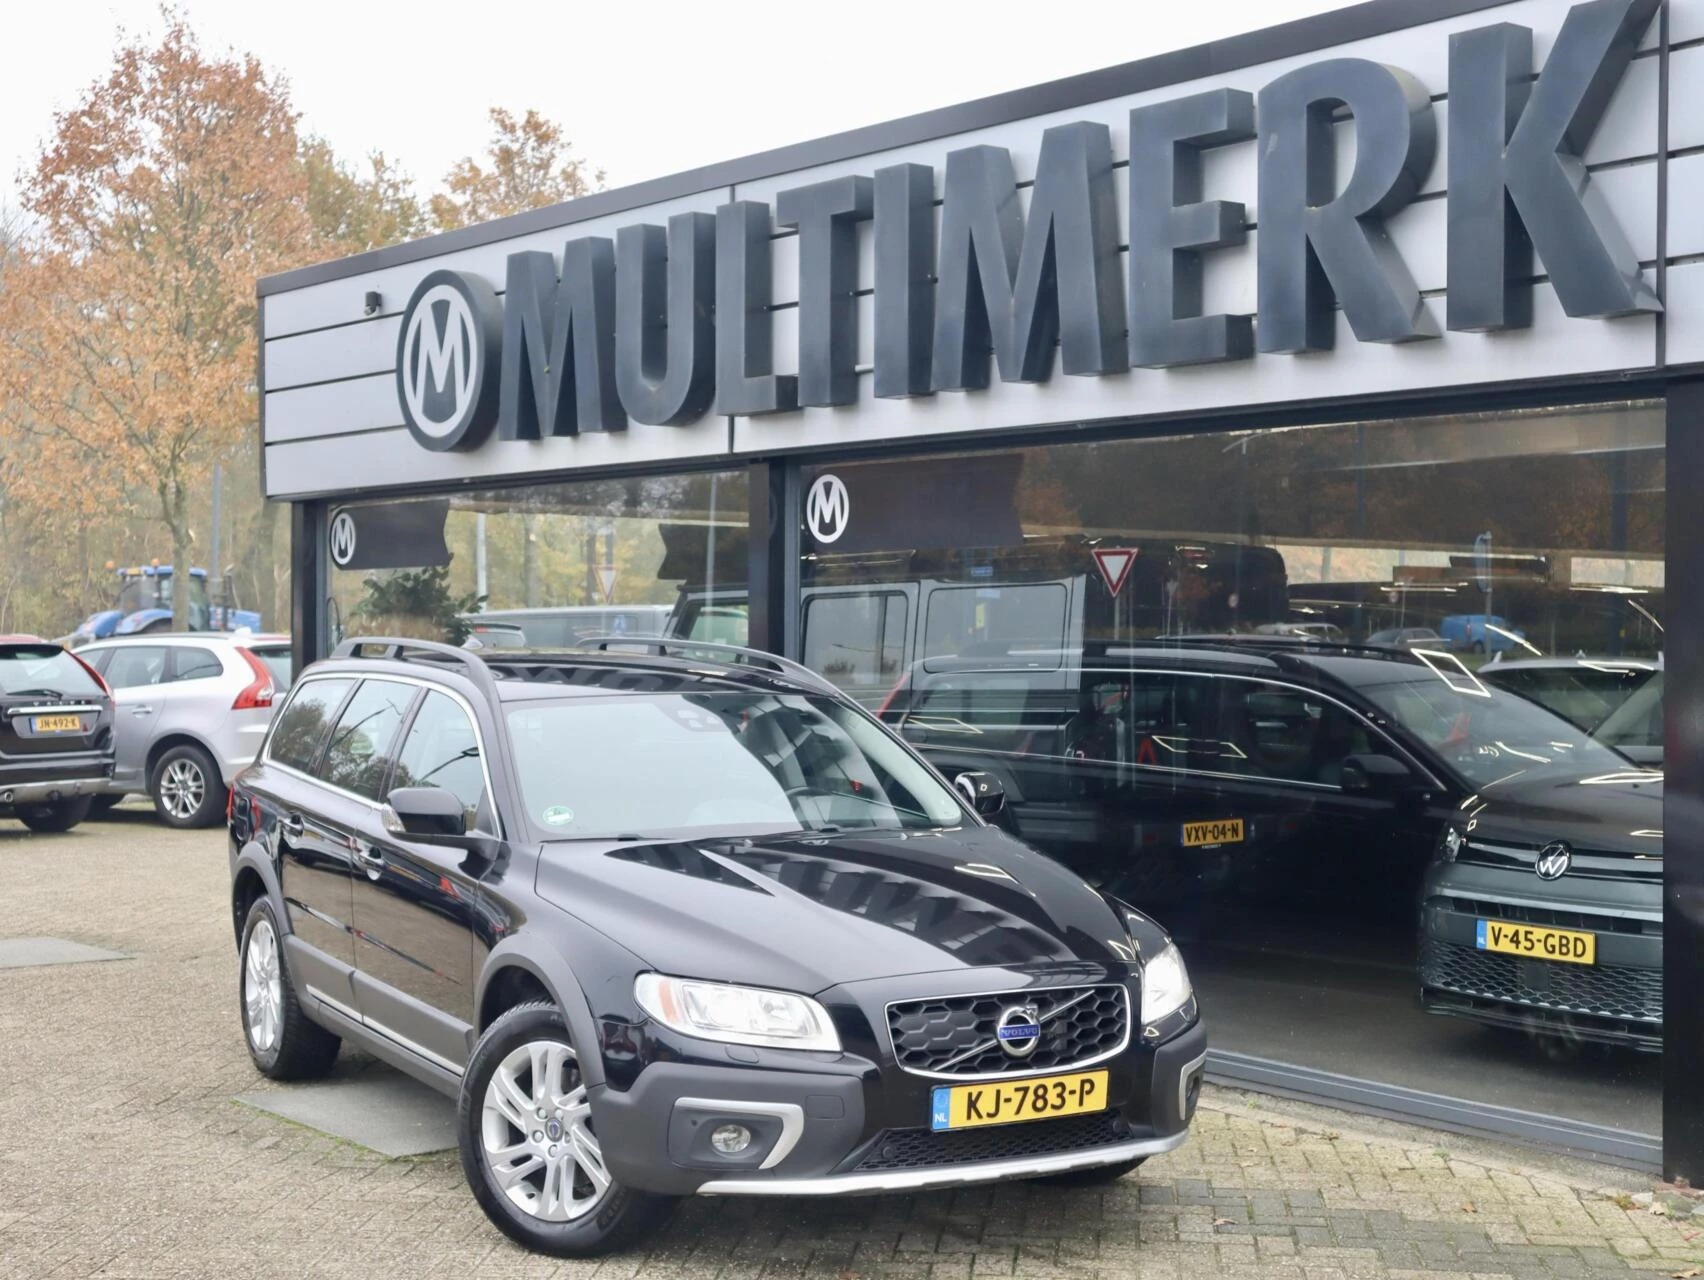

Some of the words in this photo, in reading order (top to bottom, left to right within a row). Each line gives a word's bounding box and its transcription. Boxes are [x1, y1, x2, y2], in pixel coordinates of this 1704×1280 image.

[499, 0, 1661, 440] MULTIMERK
[1185, 822, 1239, 842] VXV-04-N
[1491, 925, 1587, 958] V-45-GBD
[1000, 1027, 1038, 1037] VOLVO
[934, 1112, 948, 1123] NL
[966, 1077, 1095, 1121] KJ-783-P
